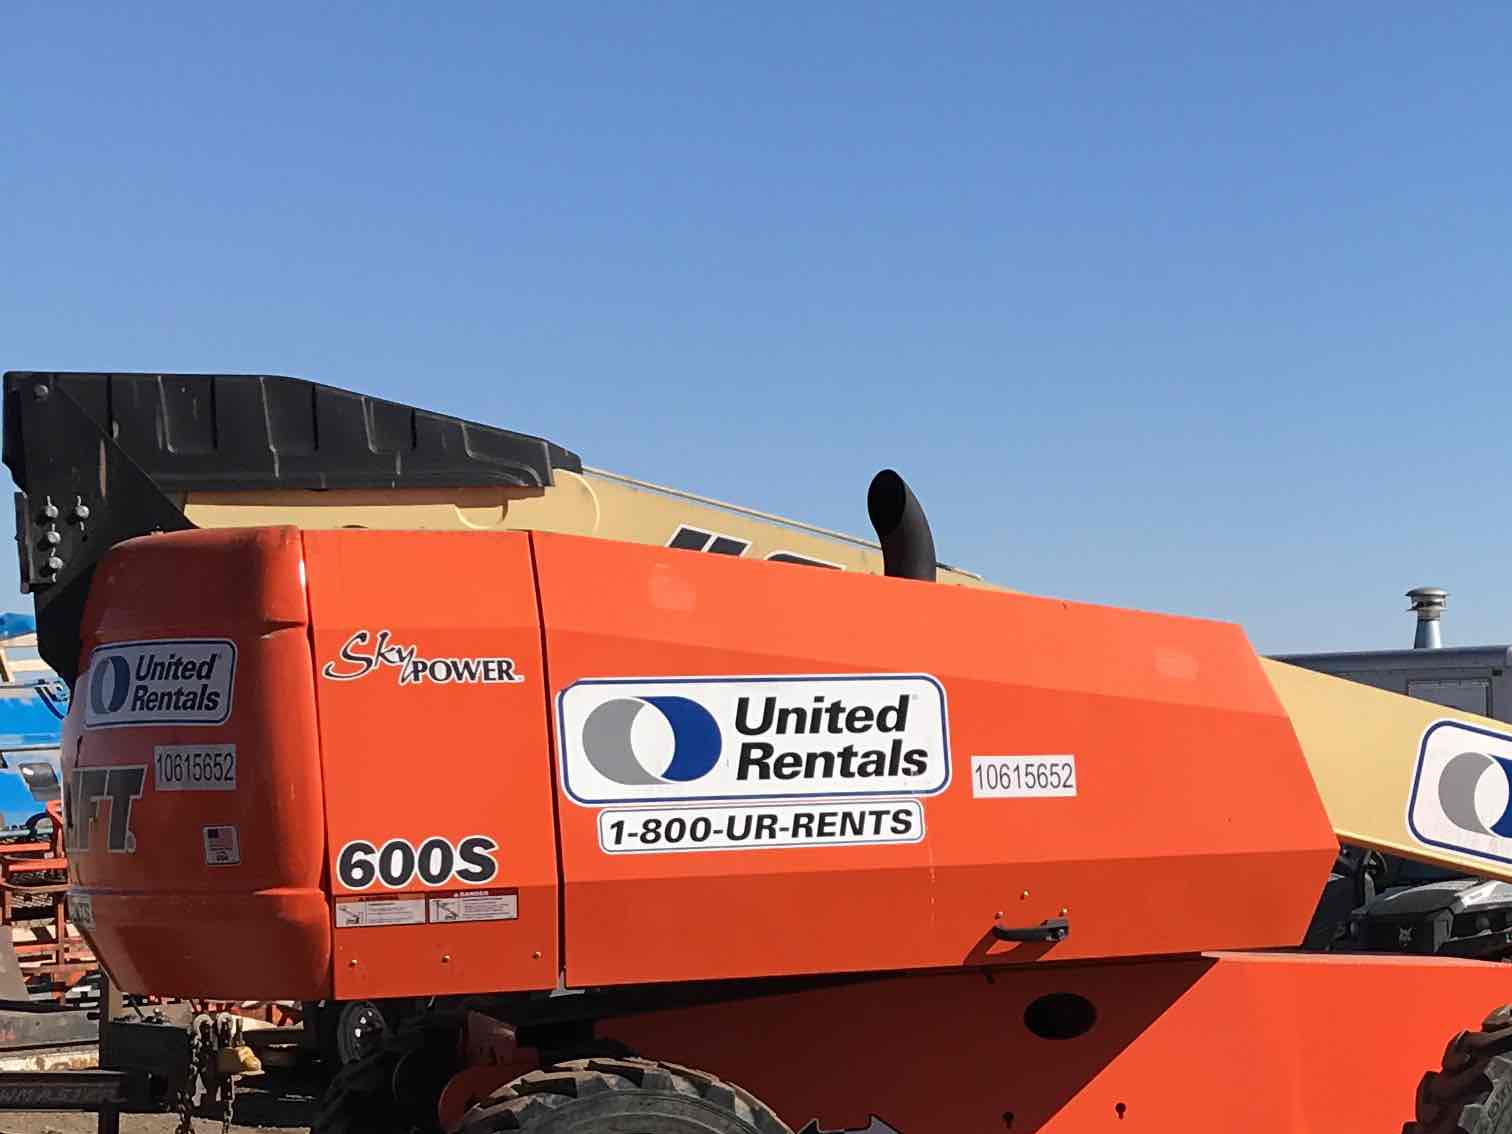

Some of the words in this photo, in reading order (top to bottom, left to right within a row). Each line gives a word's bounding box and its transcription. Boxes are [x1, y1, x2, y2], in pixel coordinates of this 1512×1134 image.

[135, 653, 218, 682] United
[413, 659, 516, 682] POWER
[131, 684, 221, 712] Rentals
[734, 694, 910, 736] United
[157, 752, 234, 782] 10615652
[735, 738, 929, 781] Rentals
[974, 763, 1074, 791] 10615652
[608, 808, 914, 845] 1-800-UR-RENTS
[338, 836, 498, 888] 600S
